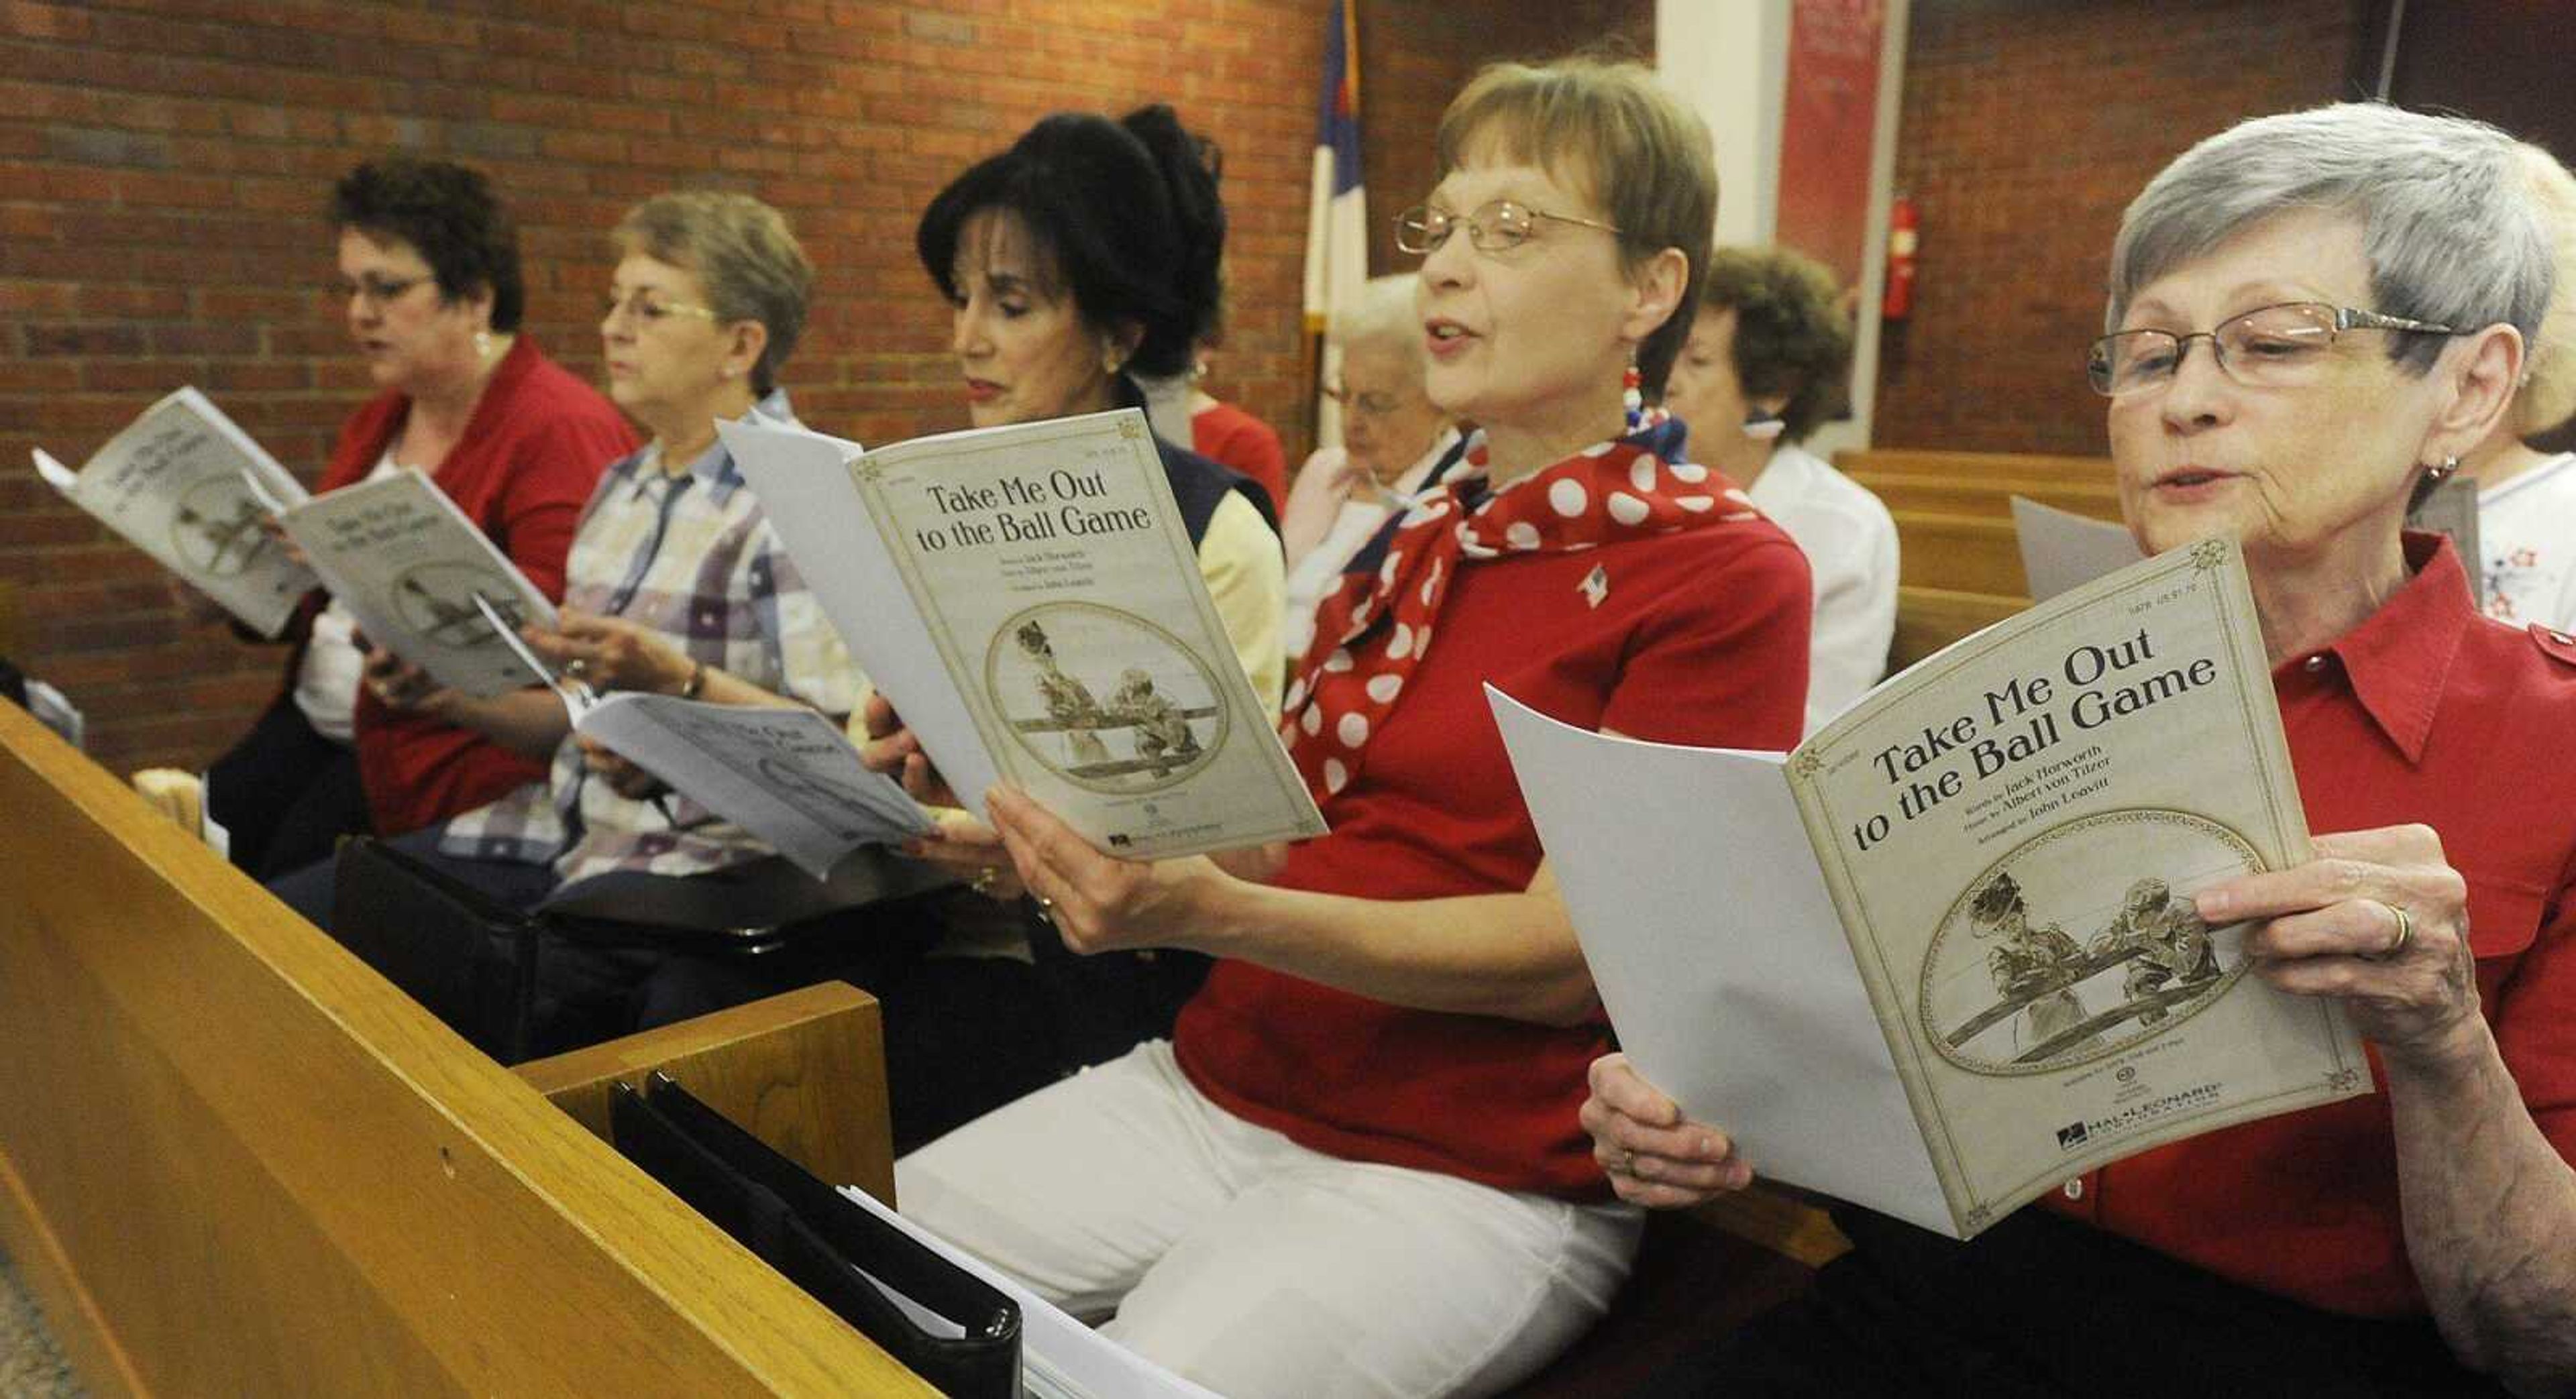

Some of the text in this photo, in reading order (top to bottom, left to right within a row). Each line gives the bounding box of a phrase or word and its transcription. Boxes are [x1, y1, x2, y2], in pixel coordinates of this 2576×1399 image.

[927, 469, 1108, 514] Take Me Out
[916, 505, 1152, 552] to the Ball Game
[1873, 715, 1977, 785] Take
[1984, 676, 2053, 728] Me
[2064, 628, 2155, 687] Out
[1854, 657, 2216, 852] to the Ball Game
[2002, 786, 2042, 812] Albert
[2046, 776, 2071, 792] von
[2005, 775, 2034, 796] Jack
[2029, 799, 2060, 820] John
